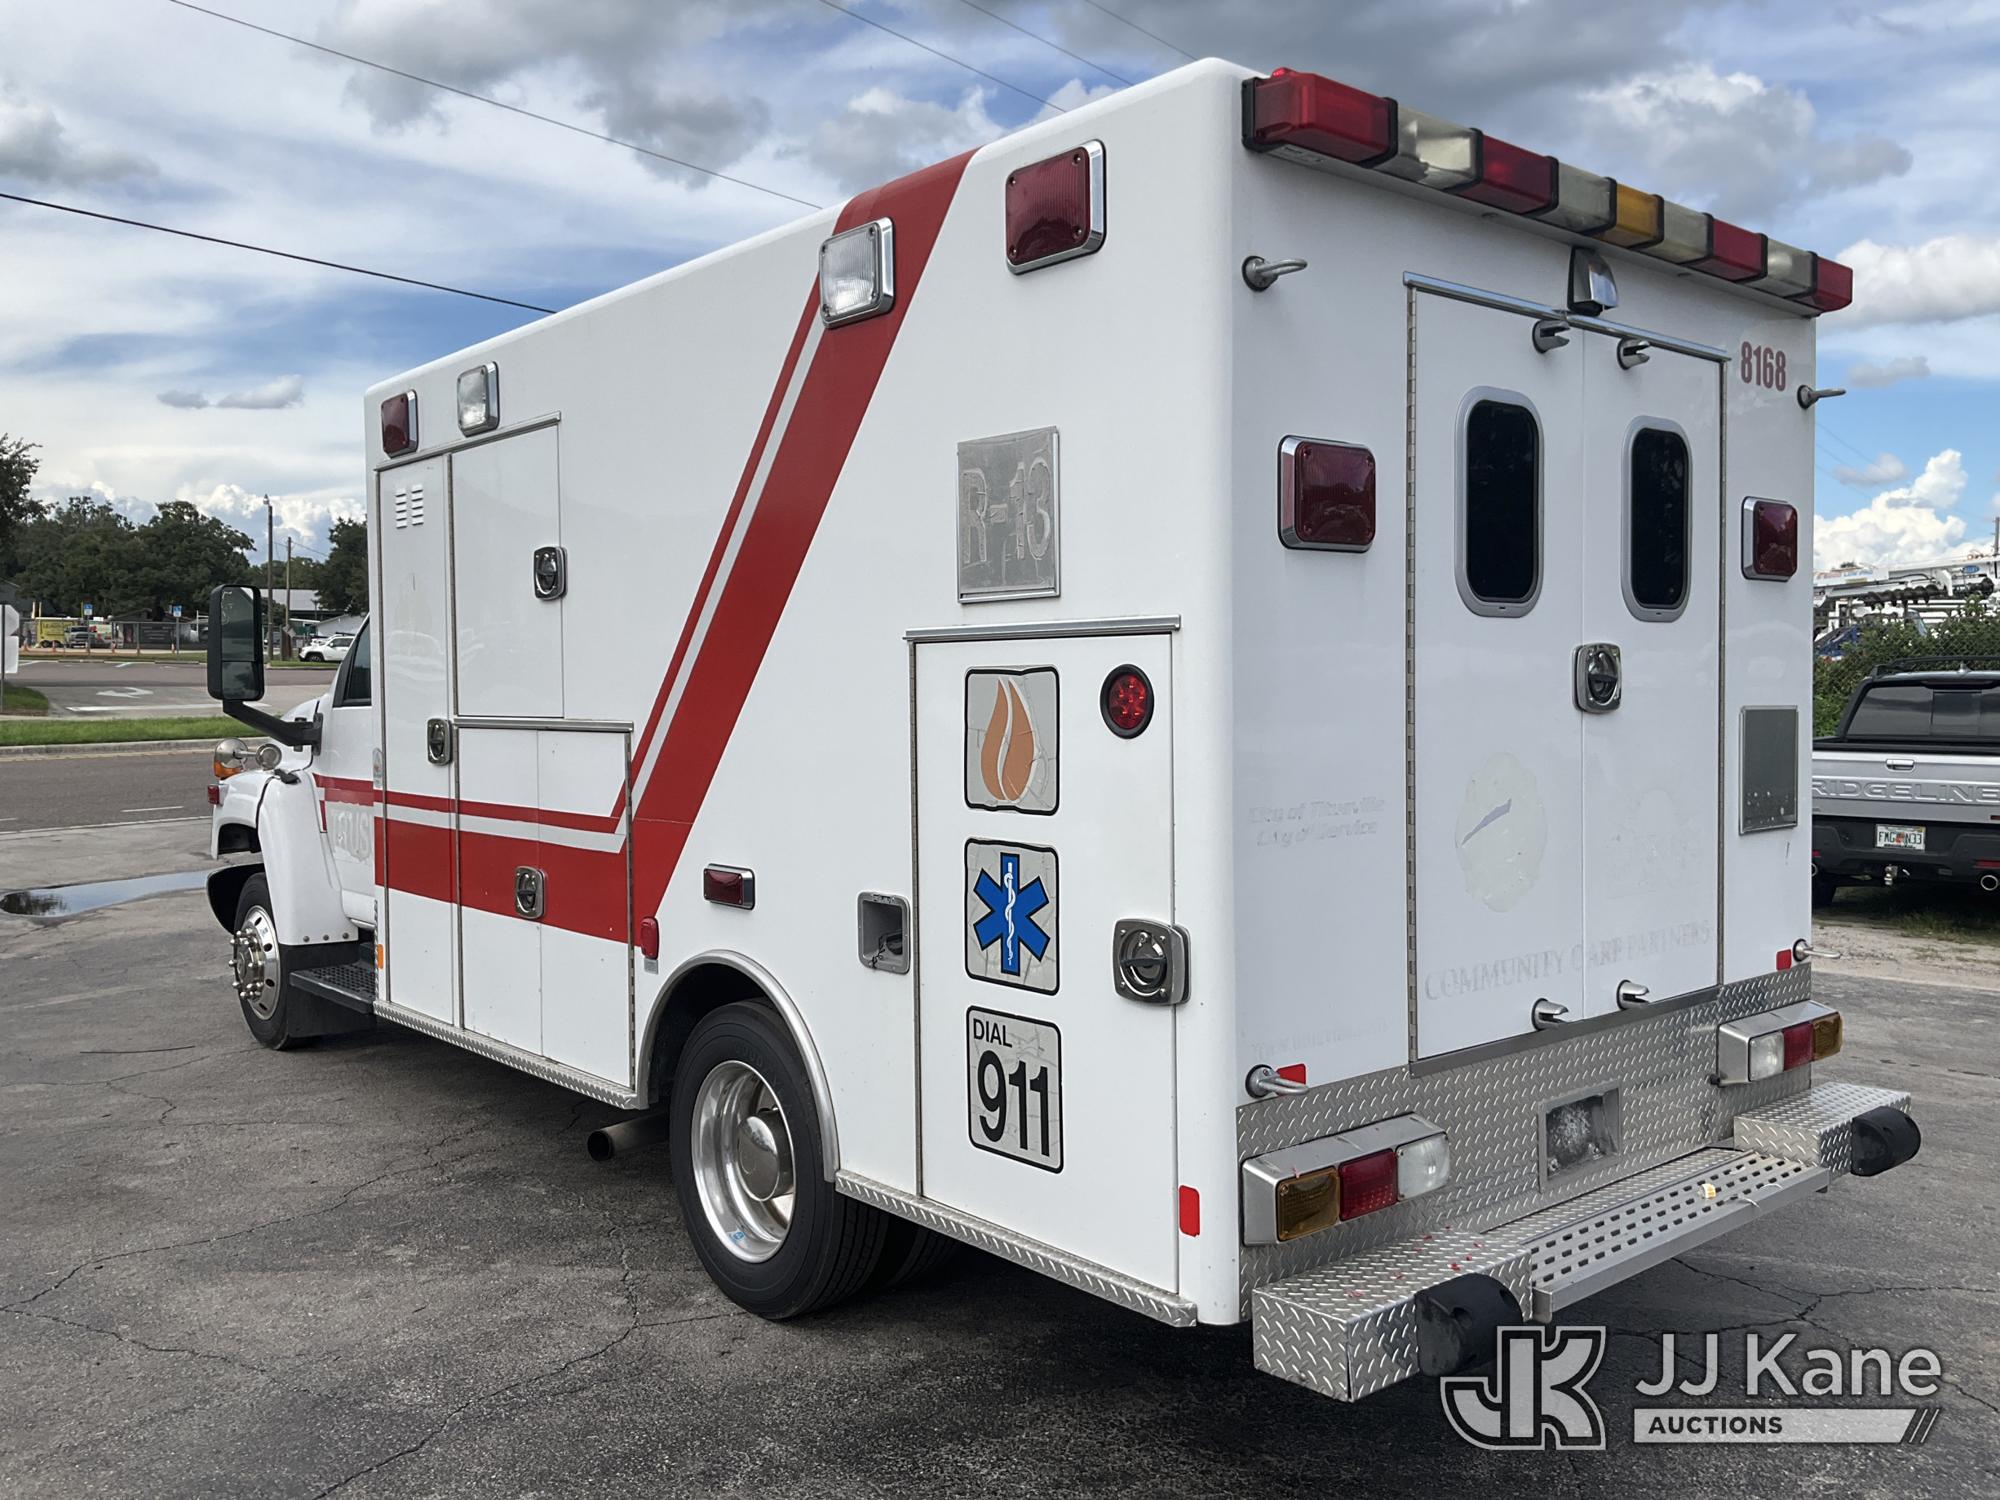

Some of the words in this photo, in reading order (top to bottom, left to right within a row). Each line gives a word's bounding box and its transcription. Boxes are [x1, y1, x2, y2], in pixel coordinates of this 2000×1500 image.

[1741, 341, 1787, 392] 8168
[961, 457, 1052, 564] R-13
[1812, 779, 2000, 803] RIDGELINE
[1424, 949, 1564, 1000] COMMUNITY
[973, 1018, 1013, 1048] DIAL
[977, 1049, 1050, 1157] 911
